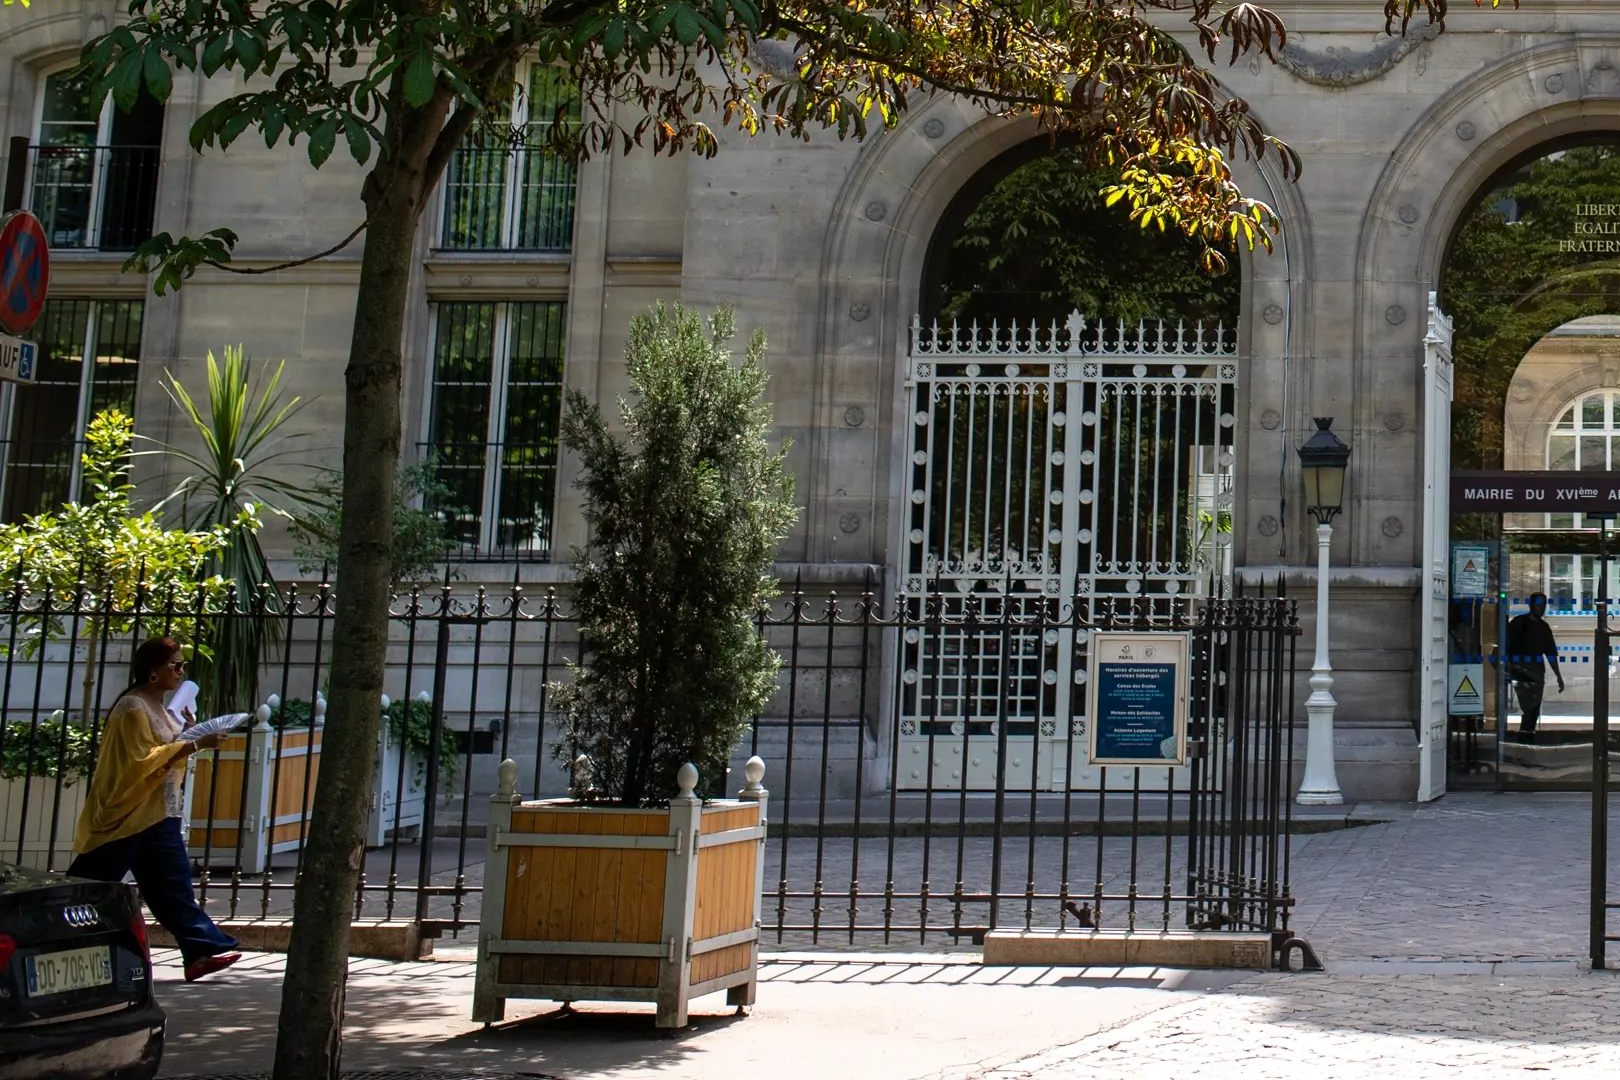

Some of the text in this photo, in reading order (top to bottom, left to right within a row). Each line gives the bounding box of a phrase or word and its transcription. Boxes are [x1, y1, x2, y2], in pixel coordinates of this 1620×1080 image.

[0, 344, 18, 369] UF
[1464, 488, 1514, 500] MAIRIE
[1525, 488, 1545, 500] DU
[1556, 486, 1599, 500] XVIème
